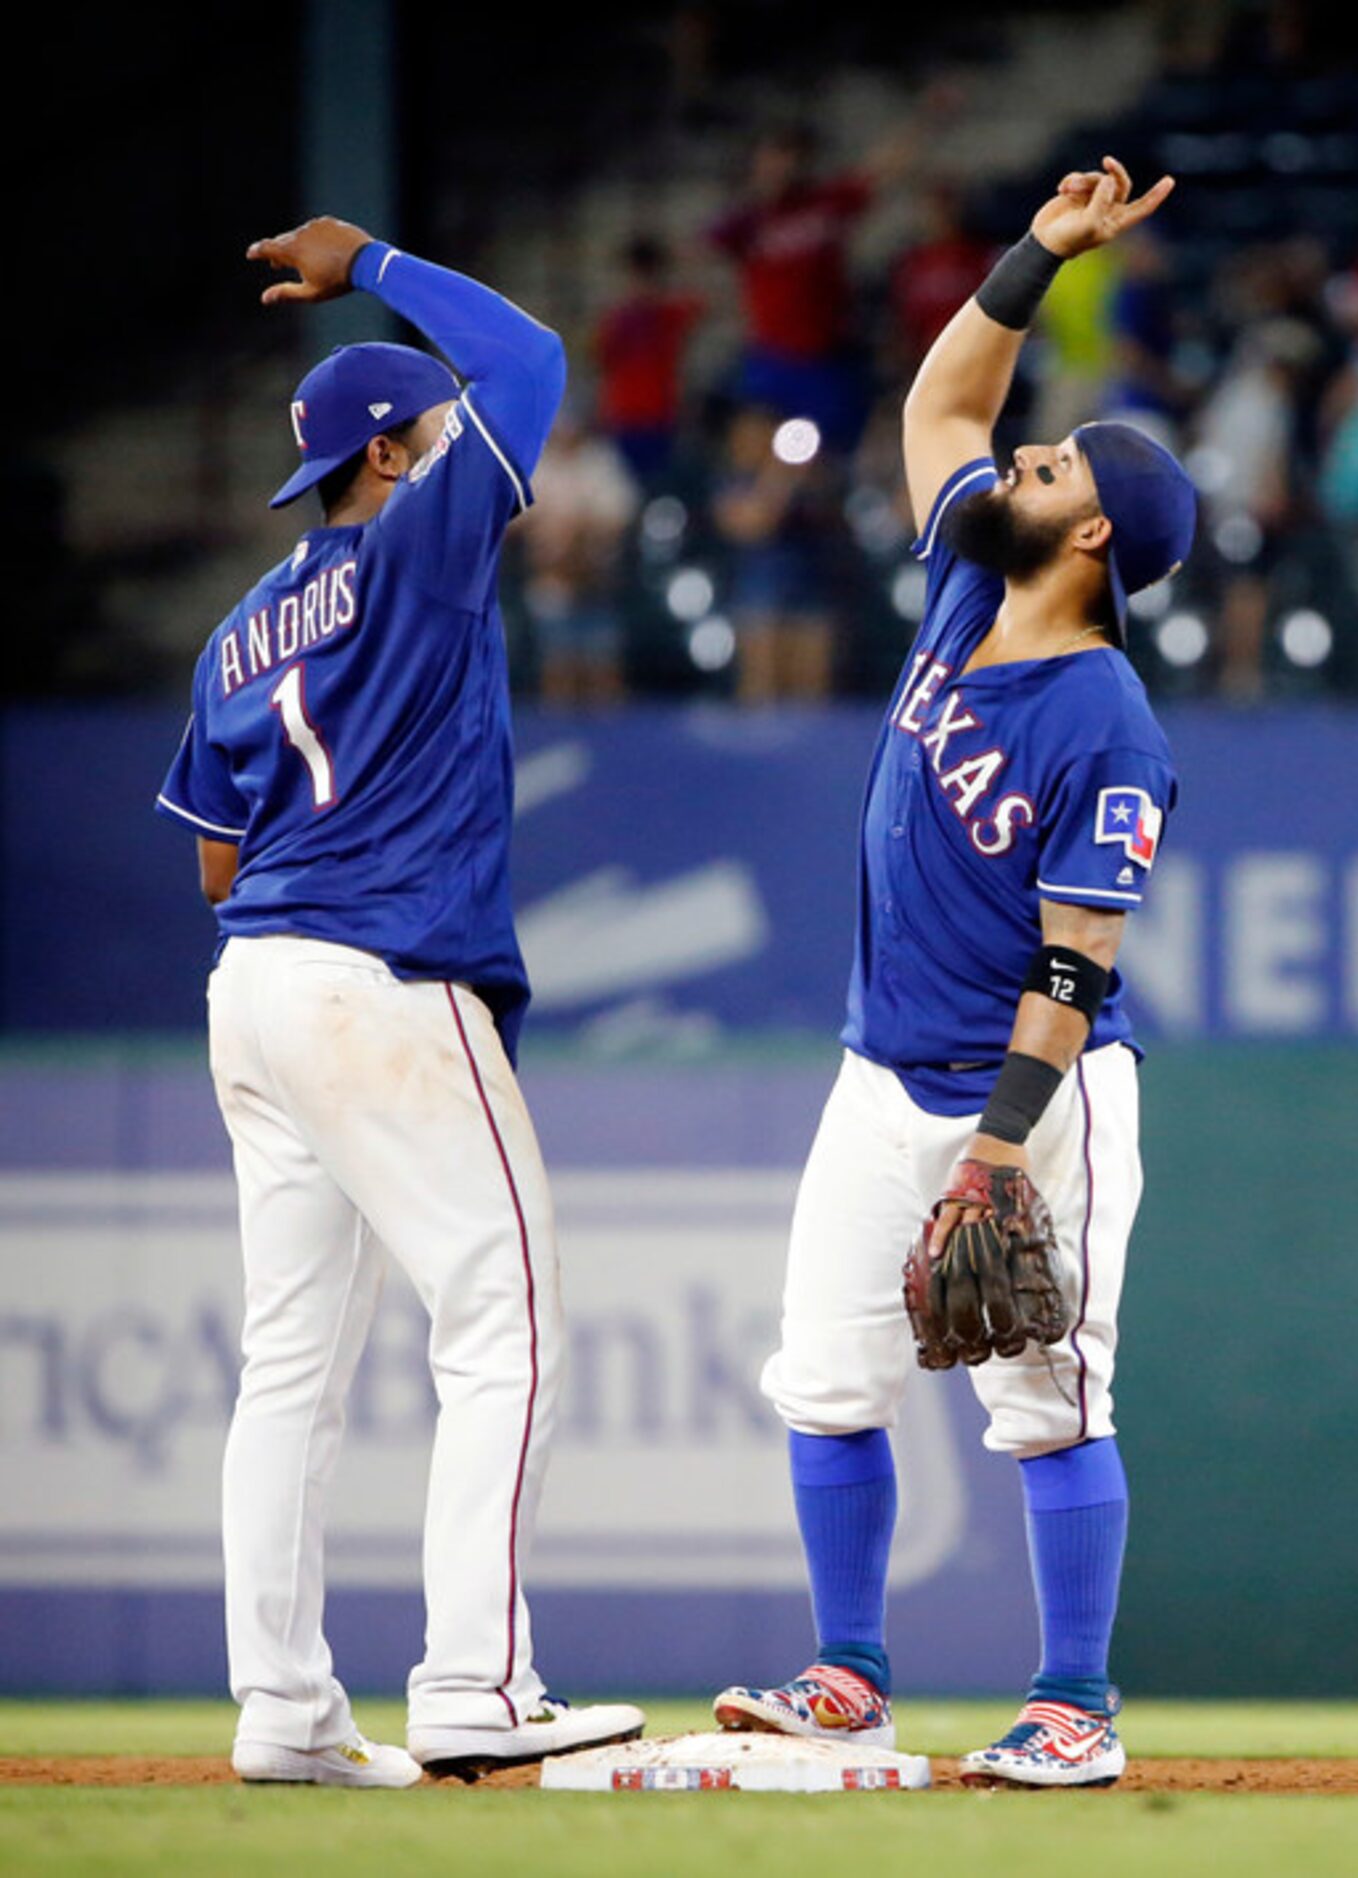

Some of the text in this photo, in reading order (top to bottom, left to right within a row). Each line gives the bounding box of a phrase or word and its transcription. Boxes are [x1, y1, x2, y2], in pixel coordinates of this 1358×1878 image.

[220, 561, 357, 698] ANDRUS
[270, 661, 337, 812] 1
[1050, 975, 1076, 1001] 12
